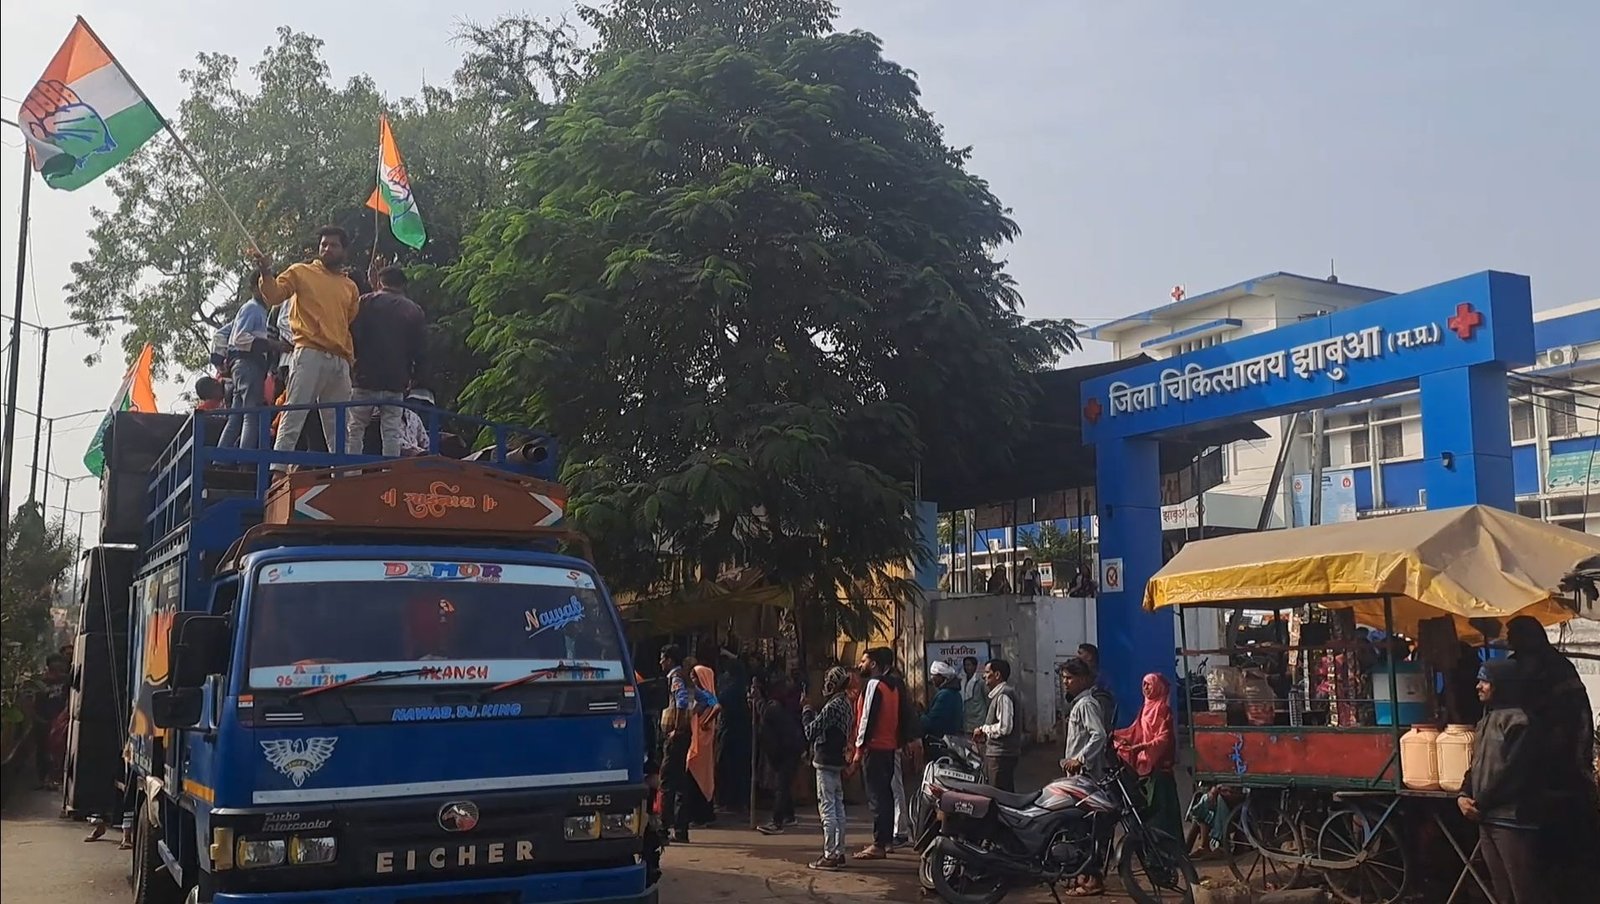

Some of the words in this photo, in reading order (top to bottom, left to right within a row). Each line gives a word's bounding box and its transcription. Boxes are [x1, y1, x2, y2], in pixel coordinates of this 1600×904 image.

[1109, 381, 1158, 417] जिला
[1160, 349, 1286, 405] चिकित्सालय
[1290, 326, 1383, 380] झाबुआ
[383, 562, 503, 578] DAMOR
[264, 812, 301, 822] Turbo
[262, 820, 332, 832] Intercooler
[376, 840, 534, 873] EICHER
